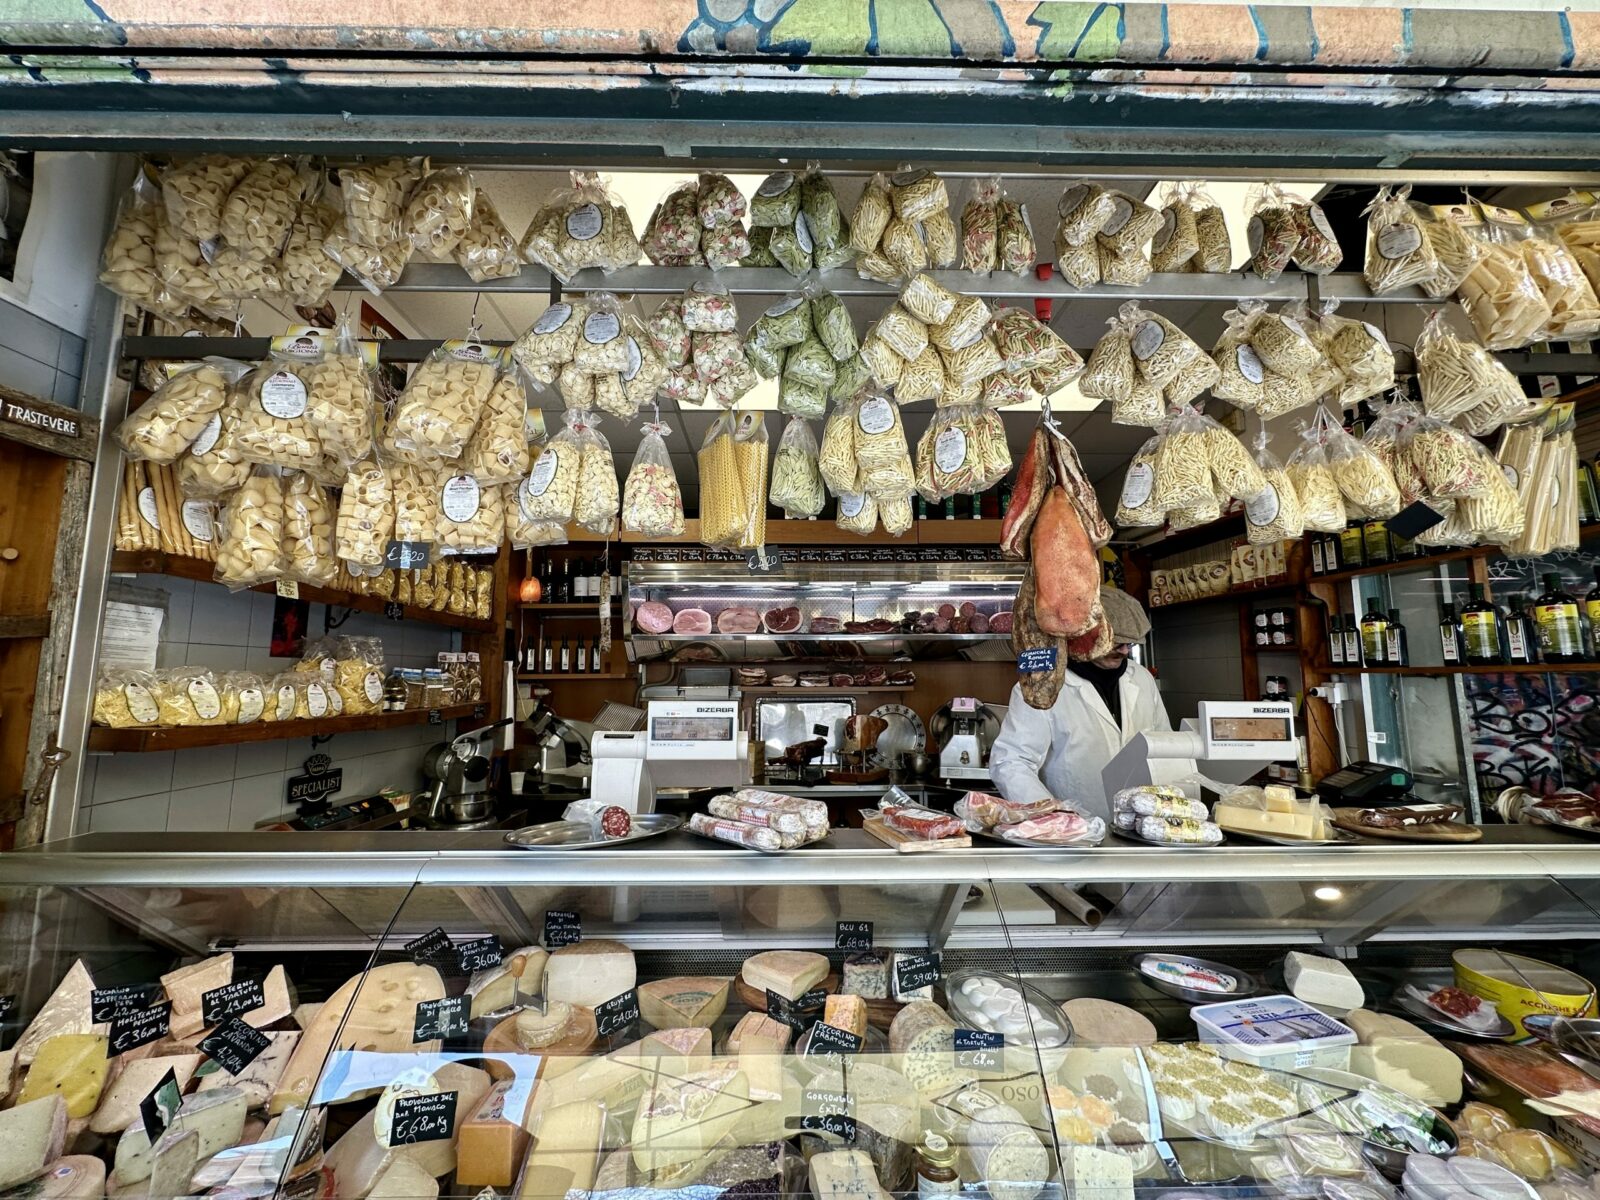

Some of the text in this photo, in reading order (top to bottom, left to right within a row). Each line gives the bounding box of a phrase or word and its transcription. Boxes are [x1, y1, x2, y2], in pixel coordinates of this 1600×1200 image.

[7, 404, 76, 433] TRASTEVERE
[387, 547, 398, 560] €
[748, 556, 758, 570] €
[1019, 662, 1026, 670] €
[291, 776, 341, 797] SPECIALIST
[458, 942, 478, 952] VETTA
[836, 935, 846, 949] €
[460, 958, 470, 970] €
[900, 974, 911, 988] €
[94, 987, 130, 996] PECORINO
[206, 980, 254, 1001] MOLITERNO
[222, 985, 258, 1001] TARTUFO
[94, 994, 138, 1004] ZAFFERANO
[1520, 999, 1570, 1012] ACCIUGHE
[95, 1008, 112, 1021] €
[118, 1006, 163, 1028] MOLITERNO
[133, 1011, 167, 1026] PECORINO
[205, 1008, 221, 1021] €
[1252, 1012, 1280, 1020] FETA
[229, 1018, 268, 1046] PECORINO
[416, 1023, 430, 1038] €
[460, 1017, 468, 1032] Kg
[598, 1016, 612, 1034] €
[113, 1032, 130, 1049] €
[159, 1022, 169, 1034] Kg
[819, 1024, 855, 1042] PECORINO
[970, 1032, 995, 1040] CRUTIN
[203, 1037, 222, 1052] €
[222, 1030, 255, 1054] LAVANDA
[959, 1051, 995, 1067] € 68,00
[399, 1096, 438, 1107] PROVOLONE
[396, 1115, 447, 1138] € 68,00 Kg
[802, 1116, 814, 1129] €
[844, 1122, 856, 1139] Kg
